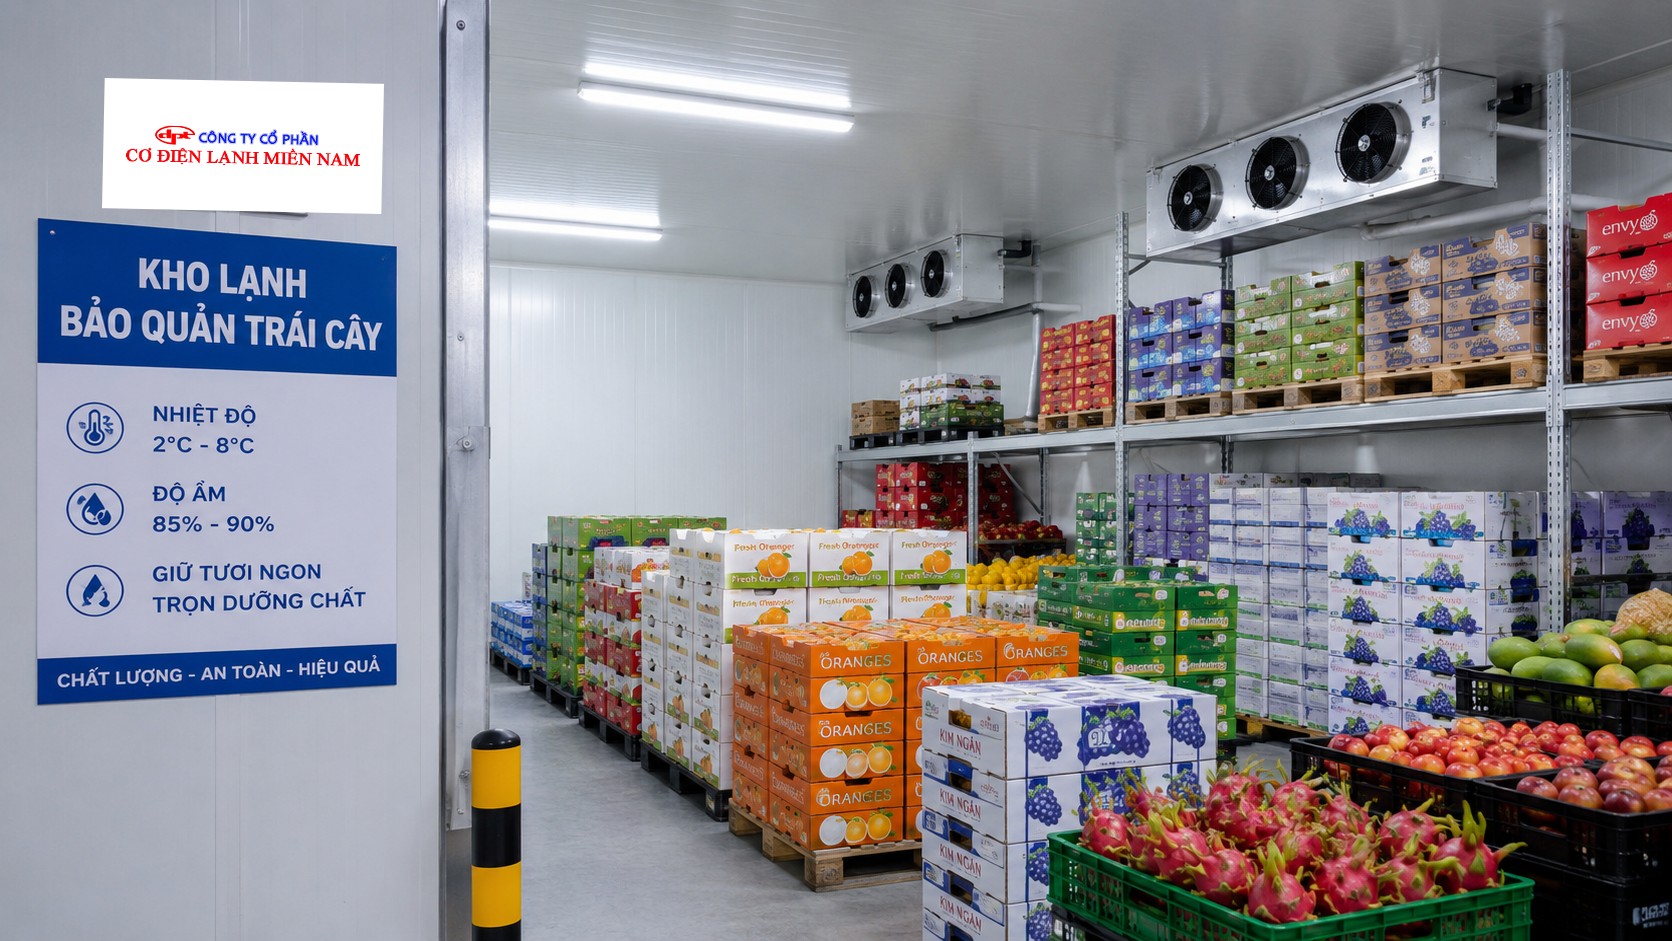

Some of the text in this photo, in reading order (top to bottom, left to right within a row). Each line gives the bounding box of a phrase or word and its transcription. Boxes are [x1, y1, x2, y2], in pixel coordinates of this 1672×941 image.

[199, 130, 237, 144] CÔNG
[240, 133, 257, 145] TY
[260, 129, 278, 145] CỔ
[282, 131, 319, 146] PHẦN
[126, 147, 361, 167] CƠ ĐIỆN LẠNH MIỀN NAM
[1602, 218, 1639, 236] envy
[139, 257, 307, 302] KHO LẠNH
[1602, 267, 1639, 285] envy
[60, 295, 383, 351] BẢO QUẢN TRÁI CÂY
[1602, 316, 1639, 333] envy
[153, 403, 256, 427] NHIỆT ĐỘ
[152, 436, 192, 453] 2°C
[216, 437, 254, 454] 8°C
[152, 482, 185, 505] ĐỘ
[152, 515, 202, 533] 85%
[226, 515, 274, 532] 90%
[152, 561, 321, 583] GIỮ TƯƠI NGON
[152, 586, 366, 617] TRỌN DƯỠNG CHẤT
[917, 649, 983, 665] ORANGES
[1003, 642, 1068, 660] ORANGES
[820, 653, 892, 670] ORANGES
[57, 666, 110, 688] CHẤT
[116, 667, 183, 687] LƯỢNG
[201, 665, 226, 681] AN
[232, 660, 281, 679] TOÀN
[299, 658, 339, 679] HIỆU
[344, 654, 381, 674] QUẢ
[820, 721, 892, 738] ORANGES
[939, 728, 954, 746] KIM
[818, 788, 892, 807] ORANGES
[939, 843, 954, 863] KIM
